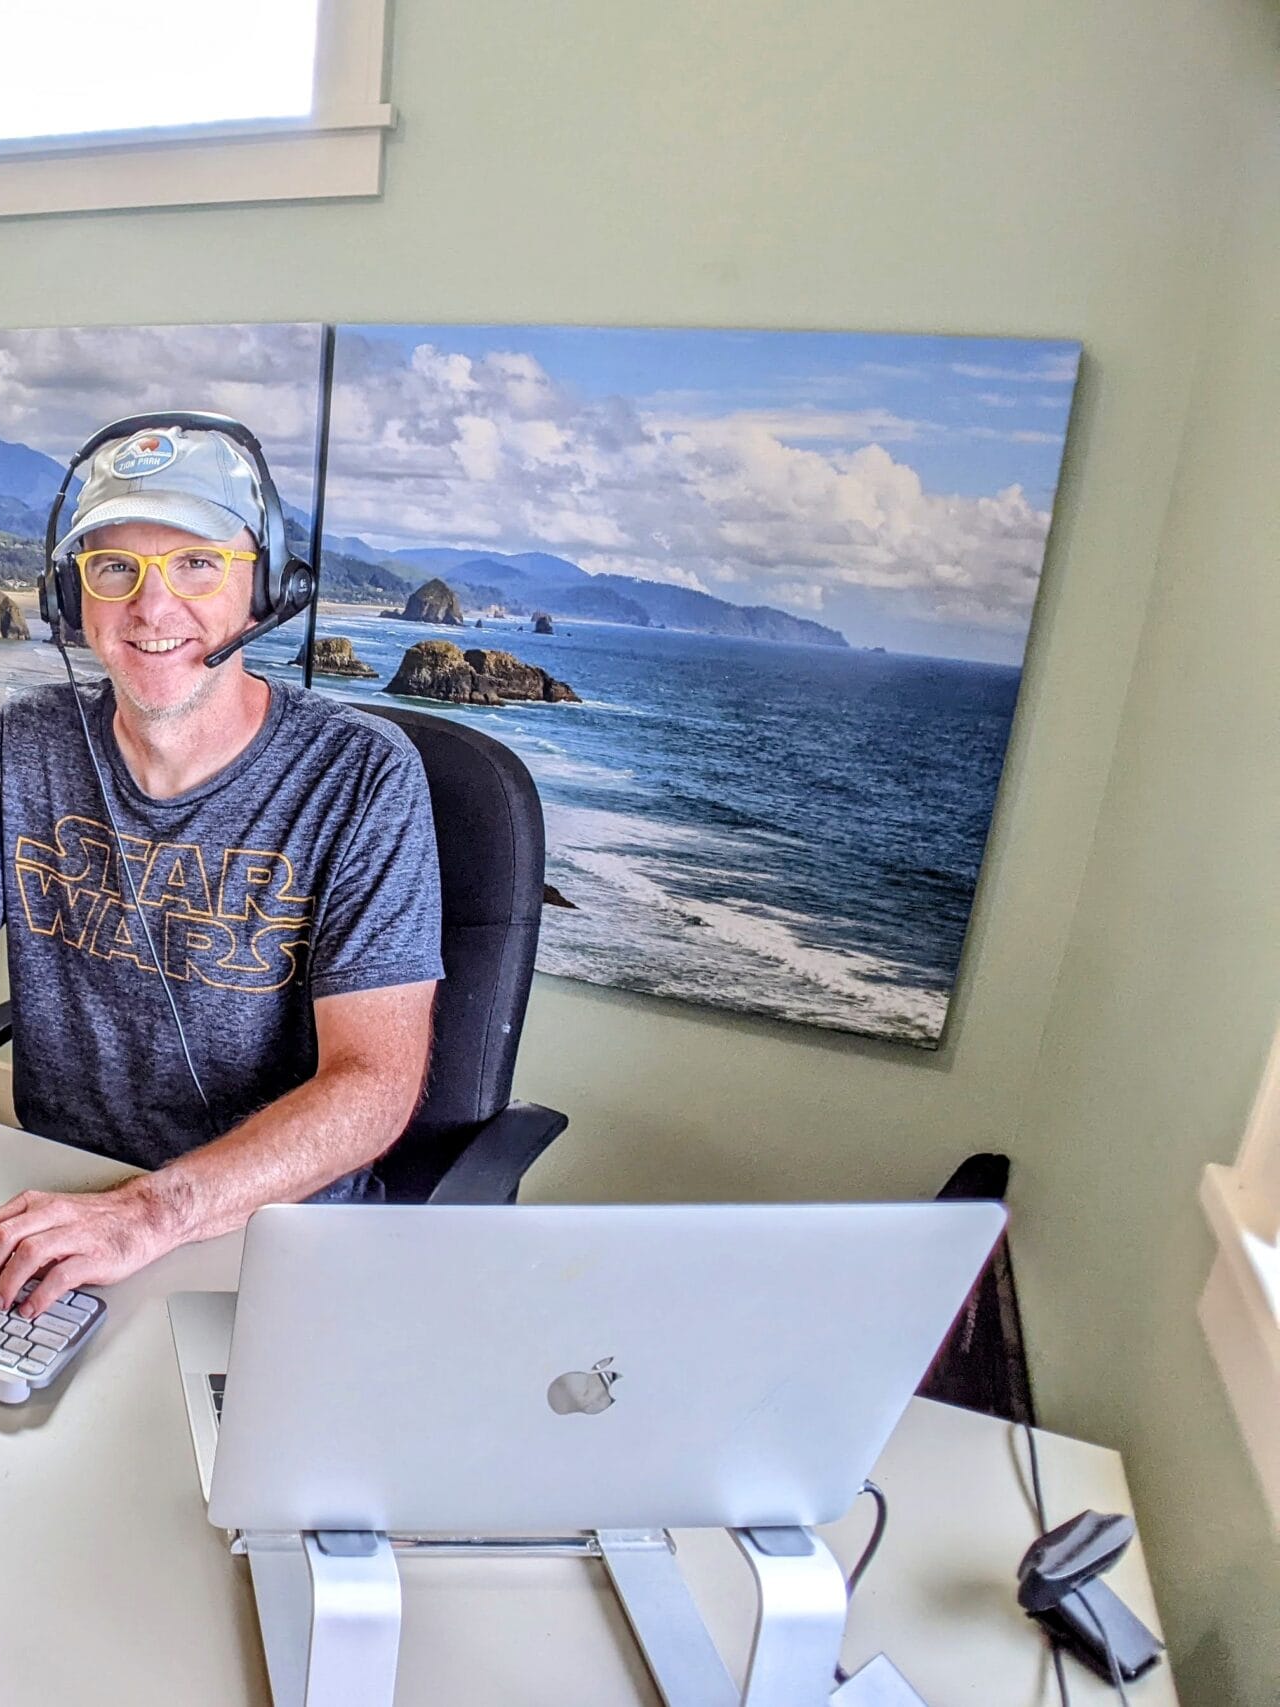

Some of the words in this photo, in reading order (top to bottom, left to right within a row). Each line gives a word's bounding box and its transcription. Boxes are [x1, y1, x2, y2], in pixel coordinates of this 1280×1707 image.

[118, 459, 135, 472] ZION
[137, 457, 161, 467] PARK
[15, 815, 316, 921] STAR
[15, 863, 313, 993] WARS
